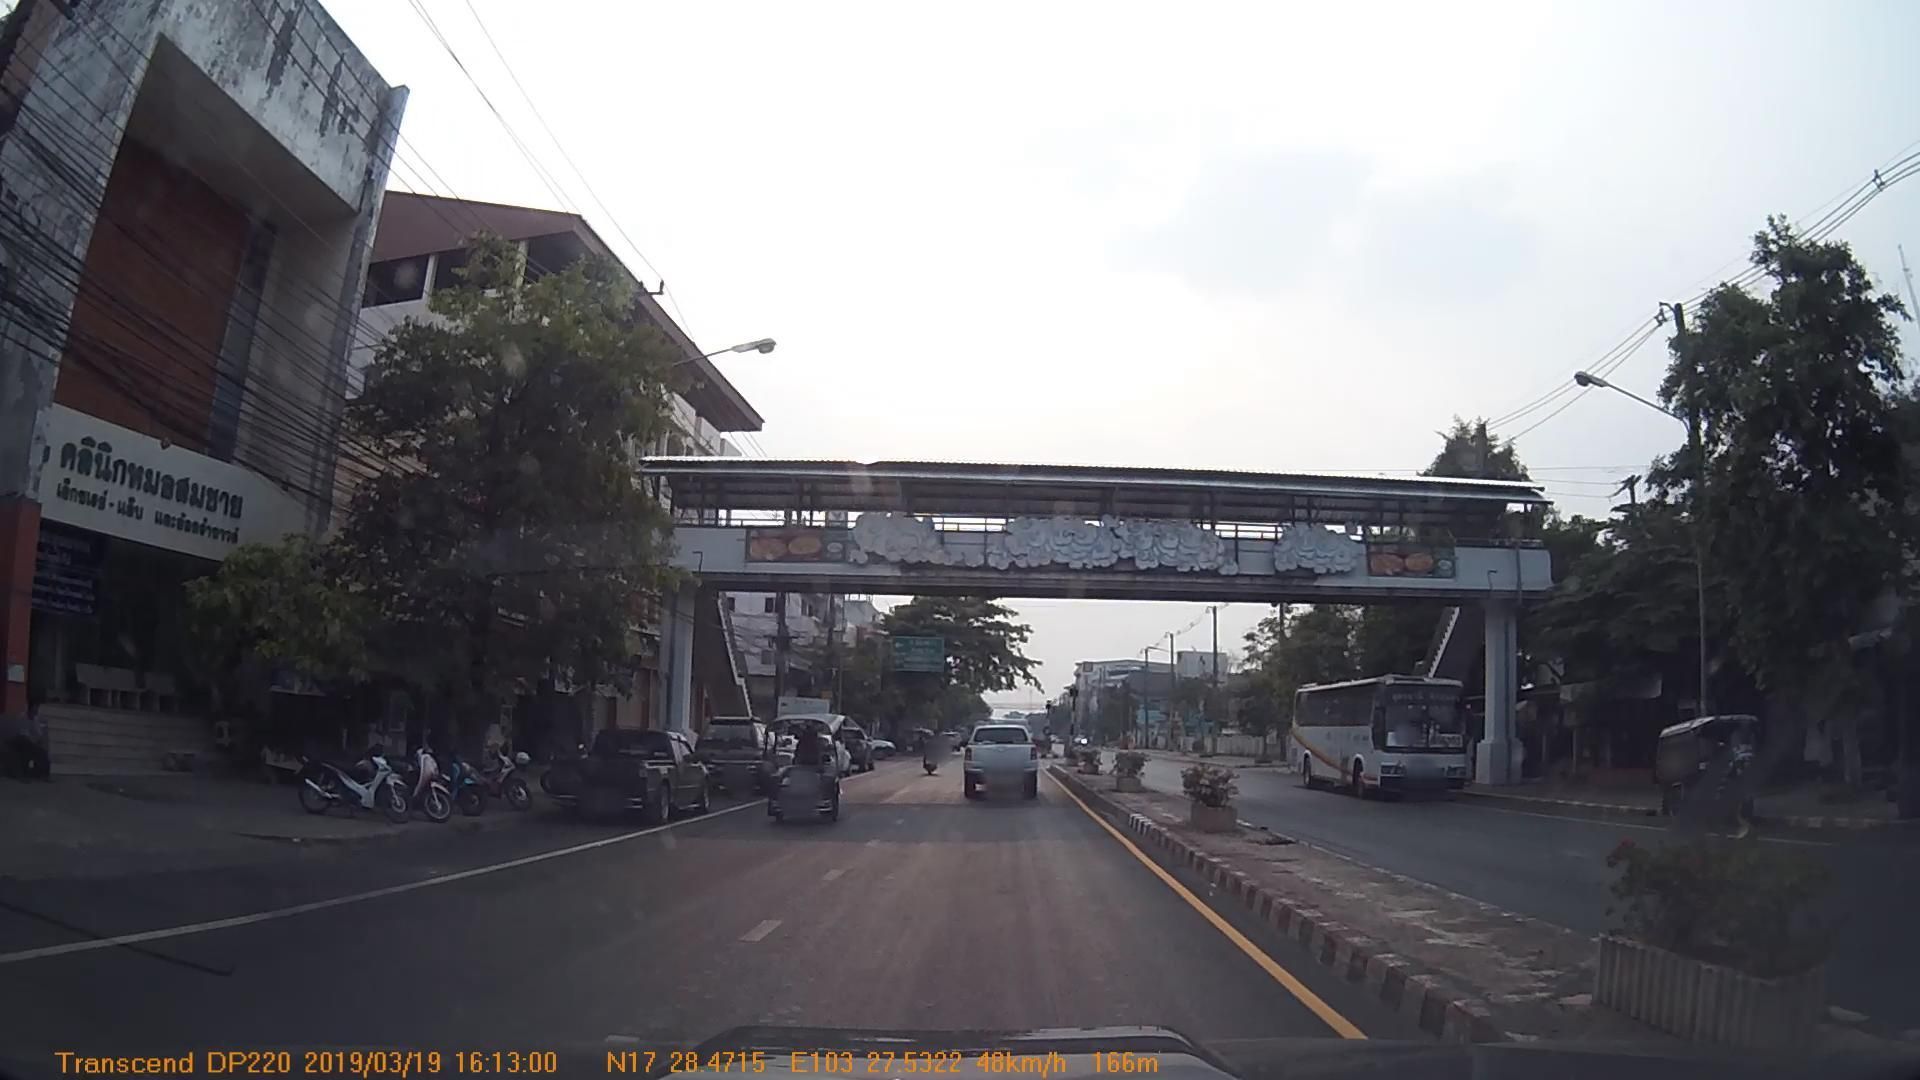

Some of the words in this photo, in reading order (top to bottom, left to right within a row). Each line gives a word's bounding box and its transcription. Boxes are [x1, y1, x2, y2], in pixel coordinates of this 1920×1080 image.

[60, 436, 244, 519] คลินิกหมอสมชาย
